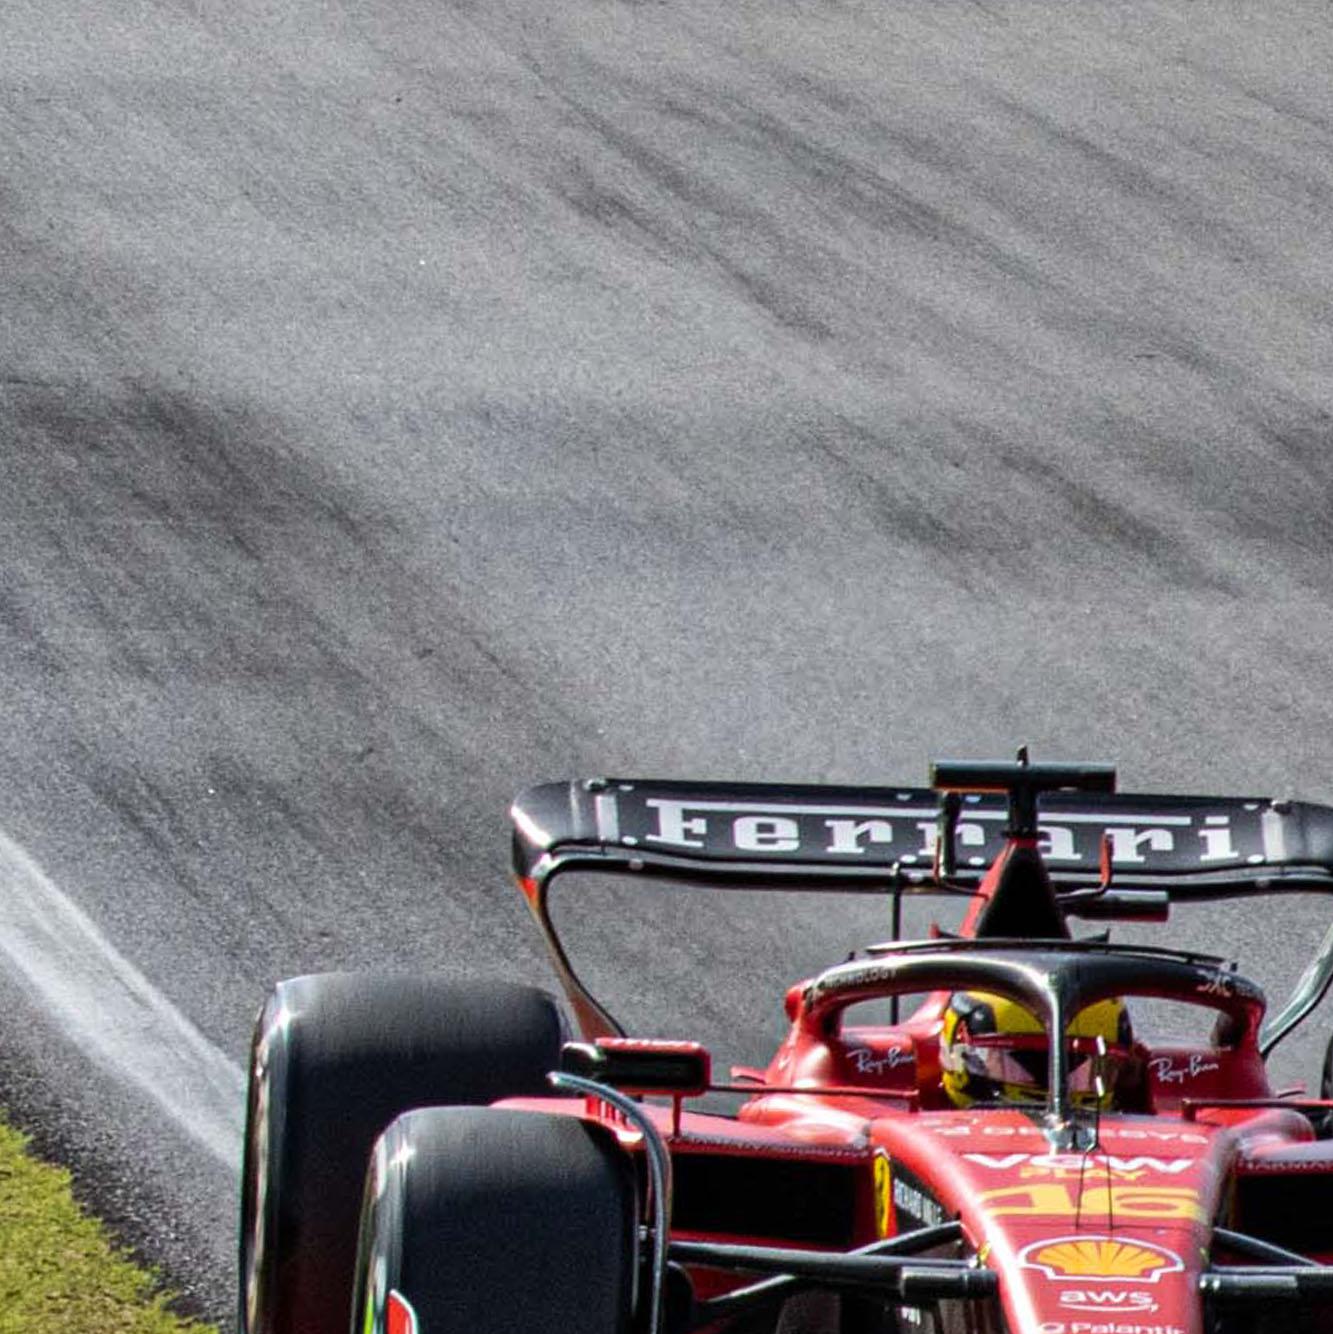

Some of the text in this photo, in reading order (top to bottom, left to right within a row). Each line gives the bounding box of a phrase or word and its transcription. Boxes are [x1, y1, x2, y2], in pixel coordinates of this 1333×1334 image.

[646, 798, 1239, 863] Ferrari
[846, 1047, 917, 1075] Ray-Ban
[1149, 1055, 1219, 1083] Ray-Ban
[962, 1153, 1195, 1173] VGW
[1020, 1166, 1150, 1180] PLAY
[975, 1183, 1202, 1219] 16
[1060, 1288, 1153, 1304] aws
